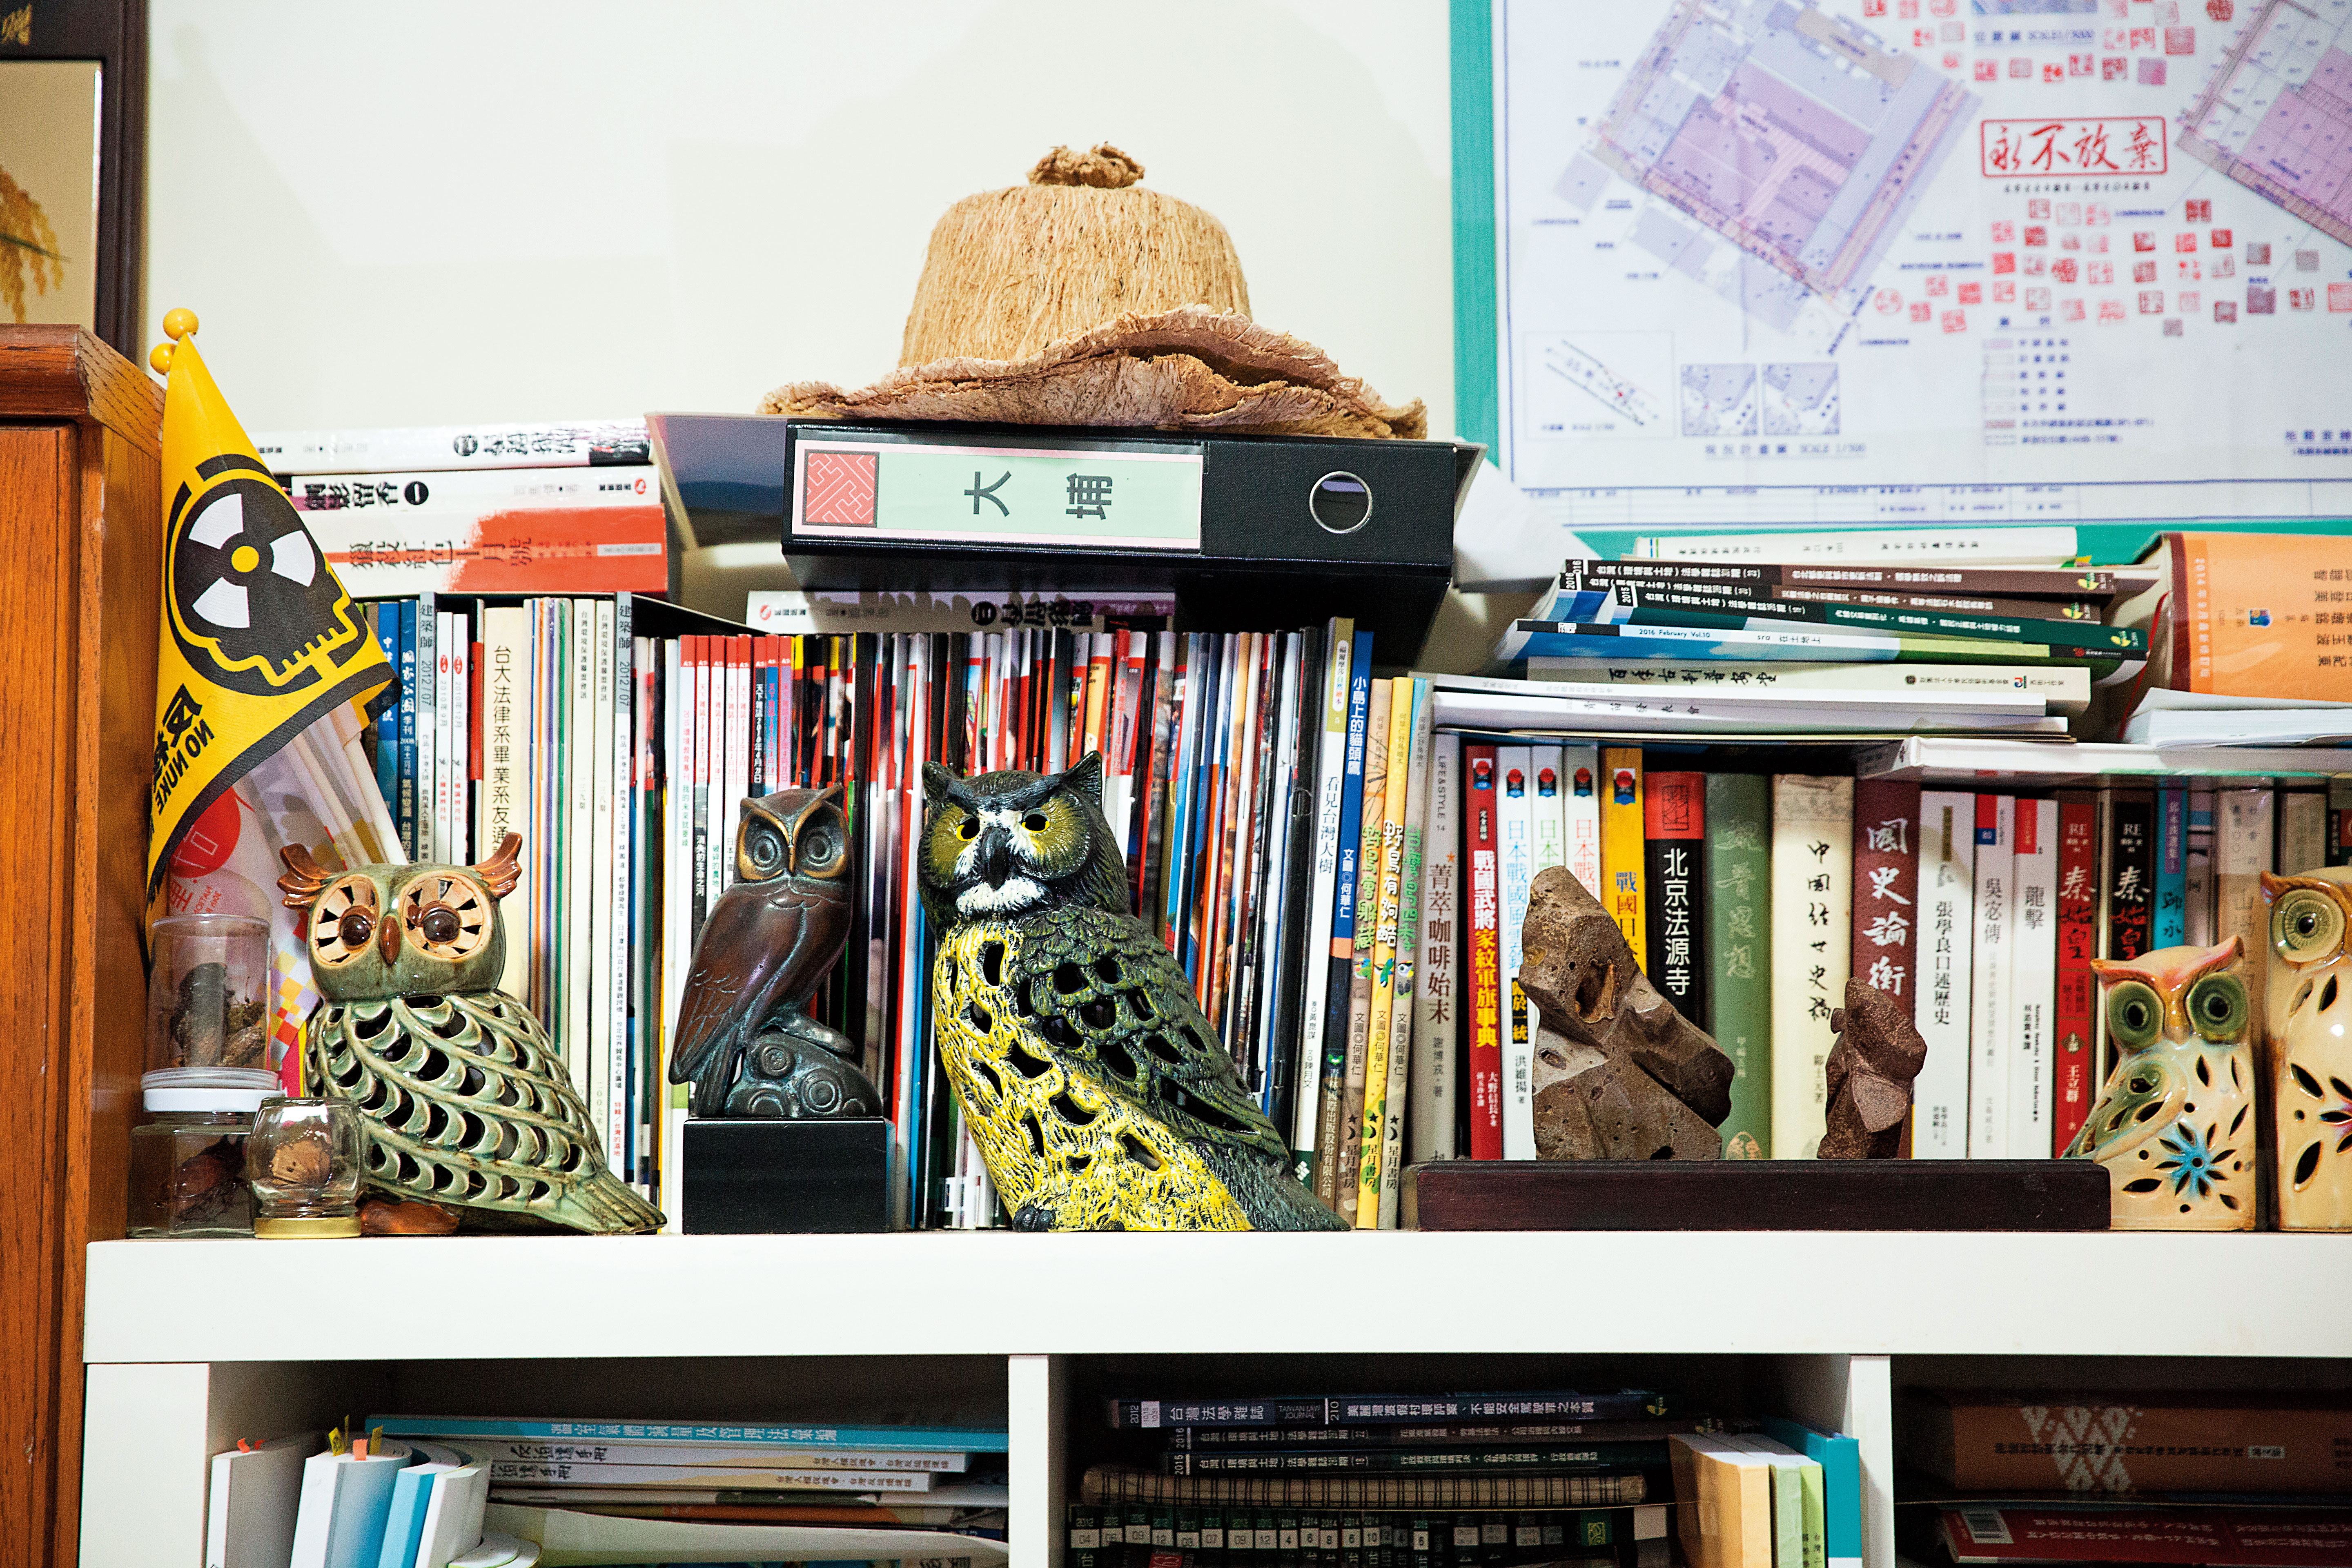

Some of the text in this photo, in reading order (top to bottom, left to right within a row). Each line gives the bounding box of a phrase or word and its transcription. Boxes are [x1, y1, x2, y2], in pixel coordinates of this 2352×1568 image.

[1989, 120, 2160, 172] 永不放棄
[963, 468, 1114, 520] 大埔
[1564, 572, 1575, 590] 2016
[1574, 560, 1582, 574] 016
[1621, 587, 1631, 604] 2015
[2195, 558, 2211, 678] 2014年9月最新修訂版
[419, 604, 433, 648] 建築師
[618, 605, 631, 649] 建築師
[1659, 630, 1687, 638] February
[1779, 635, 1821, 644] 在土地上
[1336, 646, 1347, 705] 福爾摩沙自然繪本
[1608, 667, 1778, 685] 百年古剎普安堂
[492, 645, 511, 853] 台大法律系畢業系友通
[1347, 676, 1367, 776] 小島上的貓頭鷹
[1437, 755, 1446, 819] LIFE&STYLE
[1319, 776, 1340, 874] 看見台灣大樹
[1354, 824, 1382, 951] 野鳥會躲藏
[1376, 819, 1404, 947] 野鳥有夠酷
[1398, 823, 1422, 952] 台灣鳥四季
[1863, 817, 1911, 996] 國史論衡
[1663, 847, 1690, 996] 北京法源寺
[2058, 865, 2097, 960] 秦始皇
[2111, 865, 2151, 961] 秦始皇
[1428, 863, 1453, 1025] 菁萃咖啡始末
[1473, 850, 1498, 1048] 戰國武將家紋軍旗事典
[1933, 901, 1954, 1026] 張學良口述歷史
[1343, 1145, 1359, 1189] 星月書房
[1362, 1143, 1379, 1188] 星月書房
[1385, 1145, 1401, 1190] 星月書房
[551, 1423, 837, 1442] 溫室氣體減量及管理法彙編
[1129, 1405, 1265, 1424] 2012 台灣法學雜誌
[1284, 1412, 1316, 1420] JOURNAL
[1330, 1401, 1340, 1421] 210
[510, 1442, 609, 1463] 反迫遷手冊
[1285, 1534, 1292, 1544] 4
